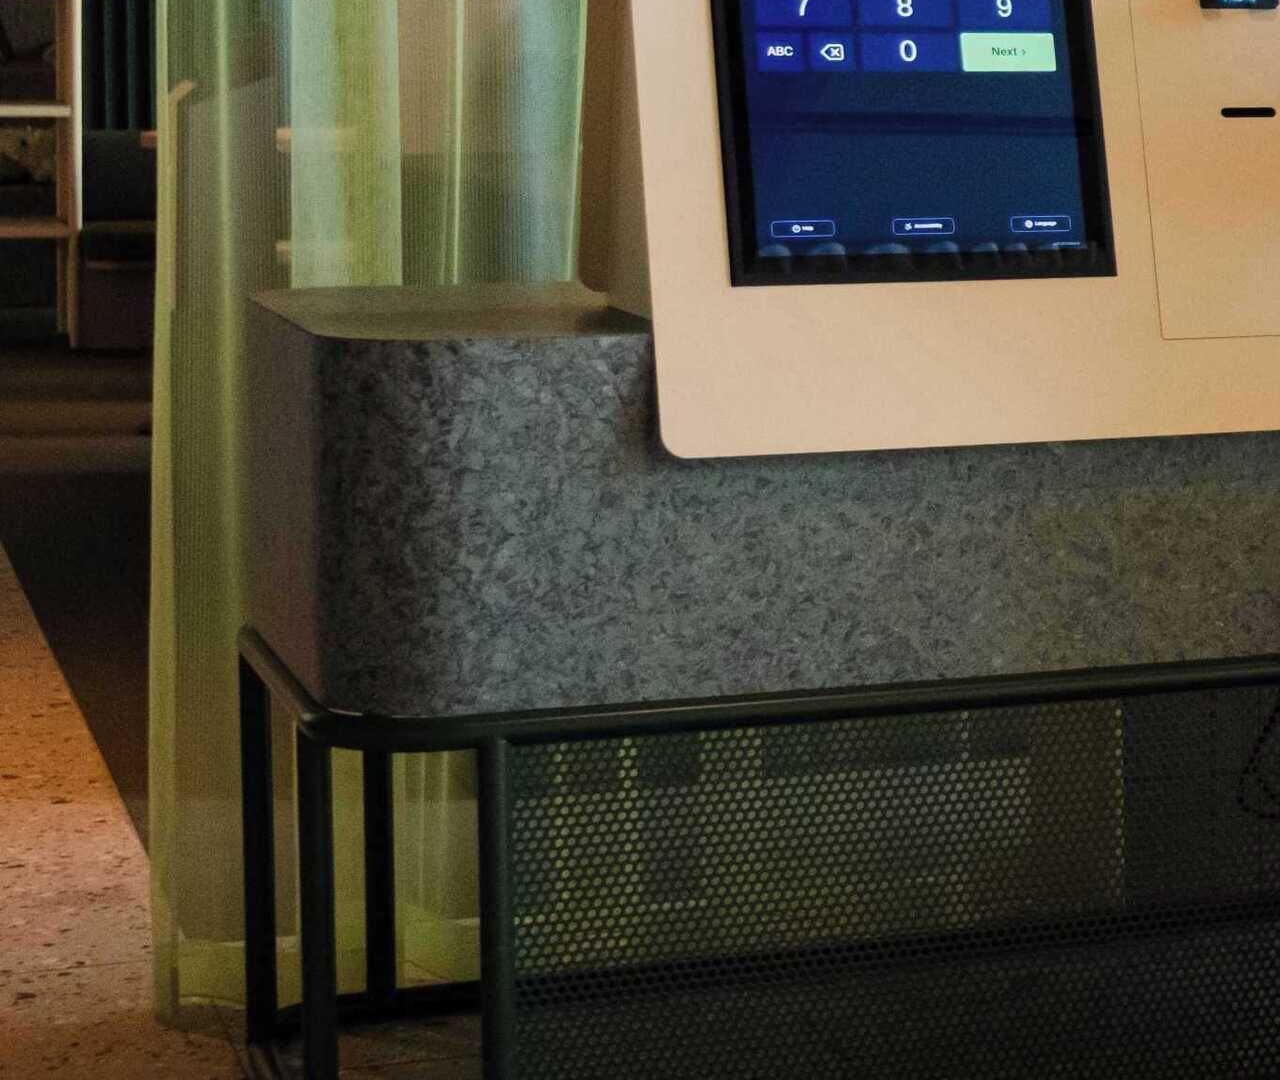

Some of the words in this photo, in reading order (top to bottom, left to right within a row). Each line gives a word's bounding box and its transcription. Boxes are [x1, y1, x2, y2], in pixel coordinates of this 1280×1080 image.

[767, 45, 794, 57] ABC
[900, 39, 917, 62] 0
[991, 46, 1018, 57] Next
